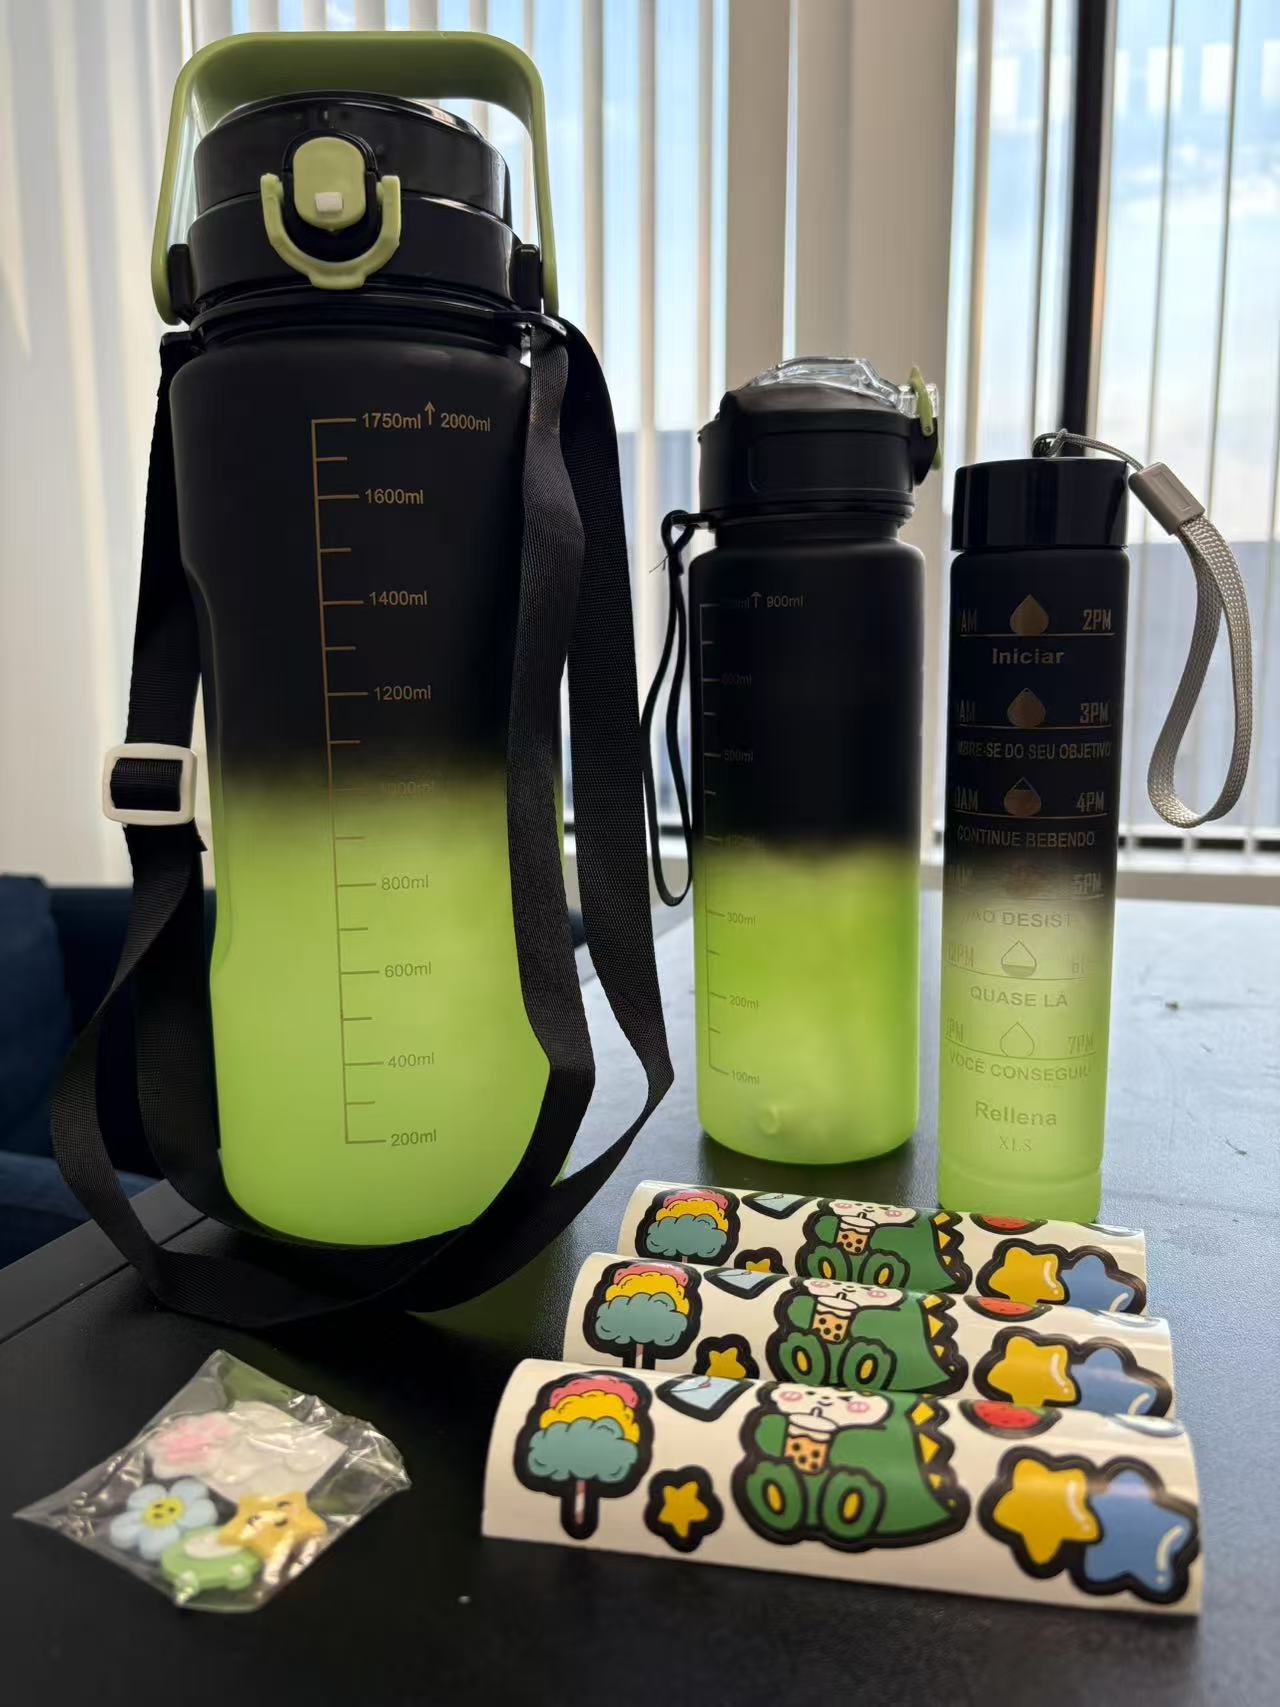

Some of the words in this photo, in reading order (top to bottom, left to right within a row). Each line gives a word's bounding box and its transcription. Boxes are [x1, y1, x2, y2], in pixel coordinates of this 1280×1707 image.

[362, 413, 421, 429] 1750ml
[440, 413, 491, 432] 2000ml
[365, 489, 424, 505] 1600ml
[369, 590, 428, 606] 1400ml
[766, 595, 805, 608] 900ml
[1082, 609, 1112, 631] 2PM
[992, 647, 1065, 665] Iniciar
[373, 684, 432, 701] 1200ml
[1080, 702, 1109, 724] 3PM
[1005, 743, 1024, 759] DO
[1028, 744, 1055, 760] SEU
[1060, 742, 1112, 760] OBJETIVO
[1075, 791, 1104, 813] 4PM
[958, 825, 1021, 847] CONTINUE
[1025, 831, 1095, 848] BEBENDO
[381, 875, 429, 890] 800ml
[727, 911, 757, 926] 300ml
[1002, 911, 1073, 928] DESIST
[384, 962, 432, 977] 600ml
[729, 995, 759, 1009] 200ml
[970, 986, 1037, 1007] QUASE
[387, 1052, 434, 1068] 400ml
[731, 1069, 760, 1085] 100ml
[975, 1100, 1057, 1127] Rellena
[390, 1129, 437, 1146] 200ml
